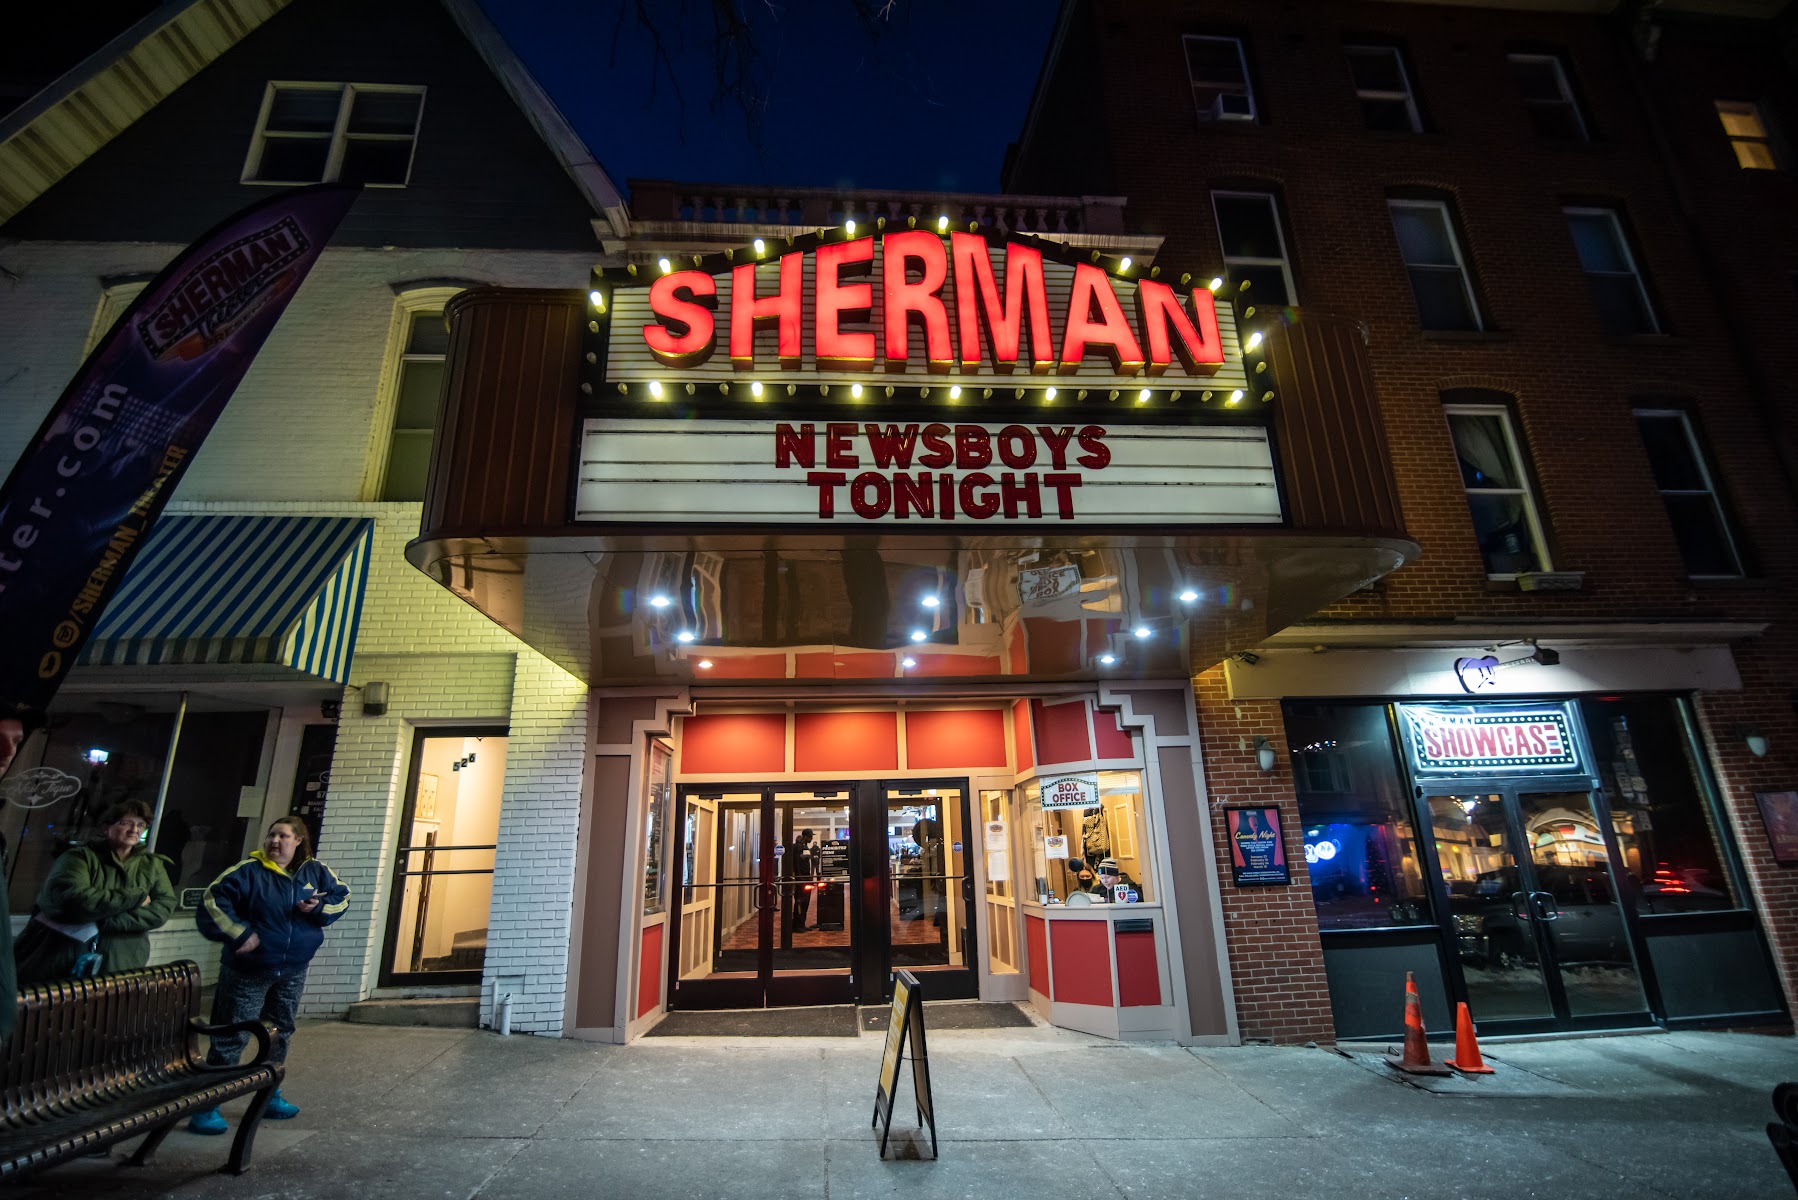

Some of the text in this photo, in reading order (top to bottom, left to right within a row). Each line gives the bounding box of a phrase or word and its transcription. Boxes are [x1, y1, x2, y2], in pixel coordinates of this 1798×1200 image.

[155, 232, 292, 339] SHERMAN
[643, 230, 1225, 370] SHERMAN
[775, 423, 1111, 471] NEWSBOYS
[0, 383, 129, 592] ter.com
[807, 471, 1082, 520] TONIGHT
[1424, 724, 1562, 758] SHOWCASE
[453, 753, 476, 771] 526
[42, 779, 73, 797] Tique
[1052, 792, 1086, 803] OFFICE
[1058, 782, 1079, 793] BOX
[1235, 830, 1276, 840] Comedy Night
